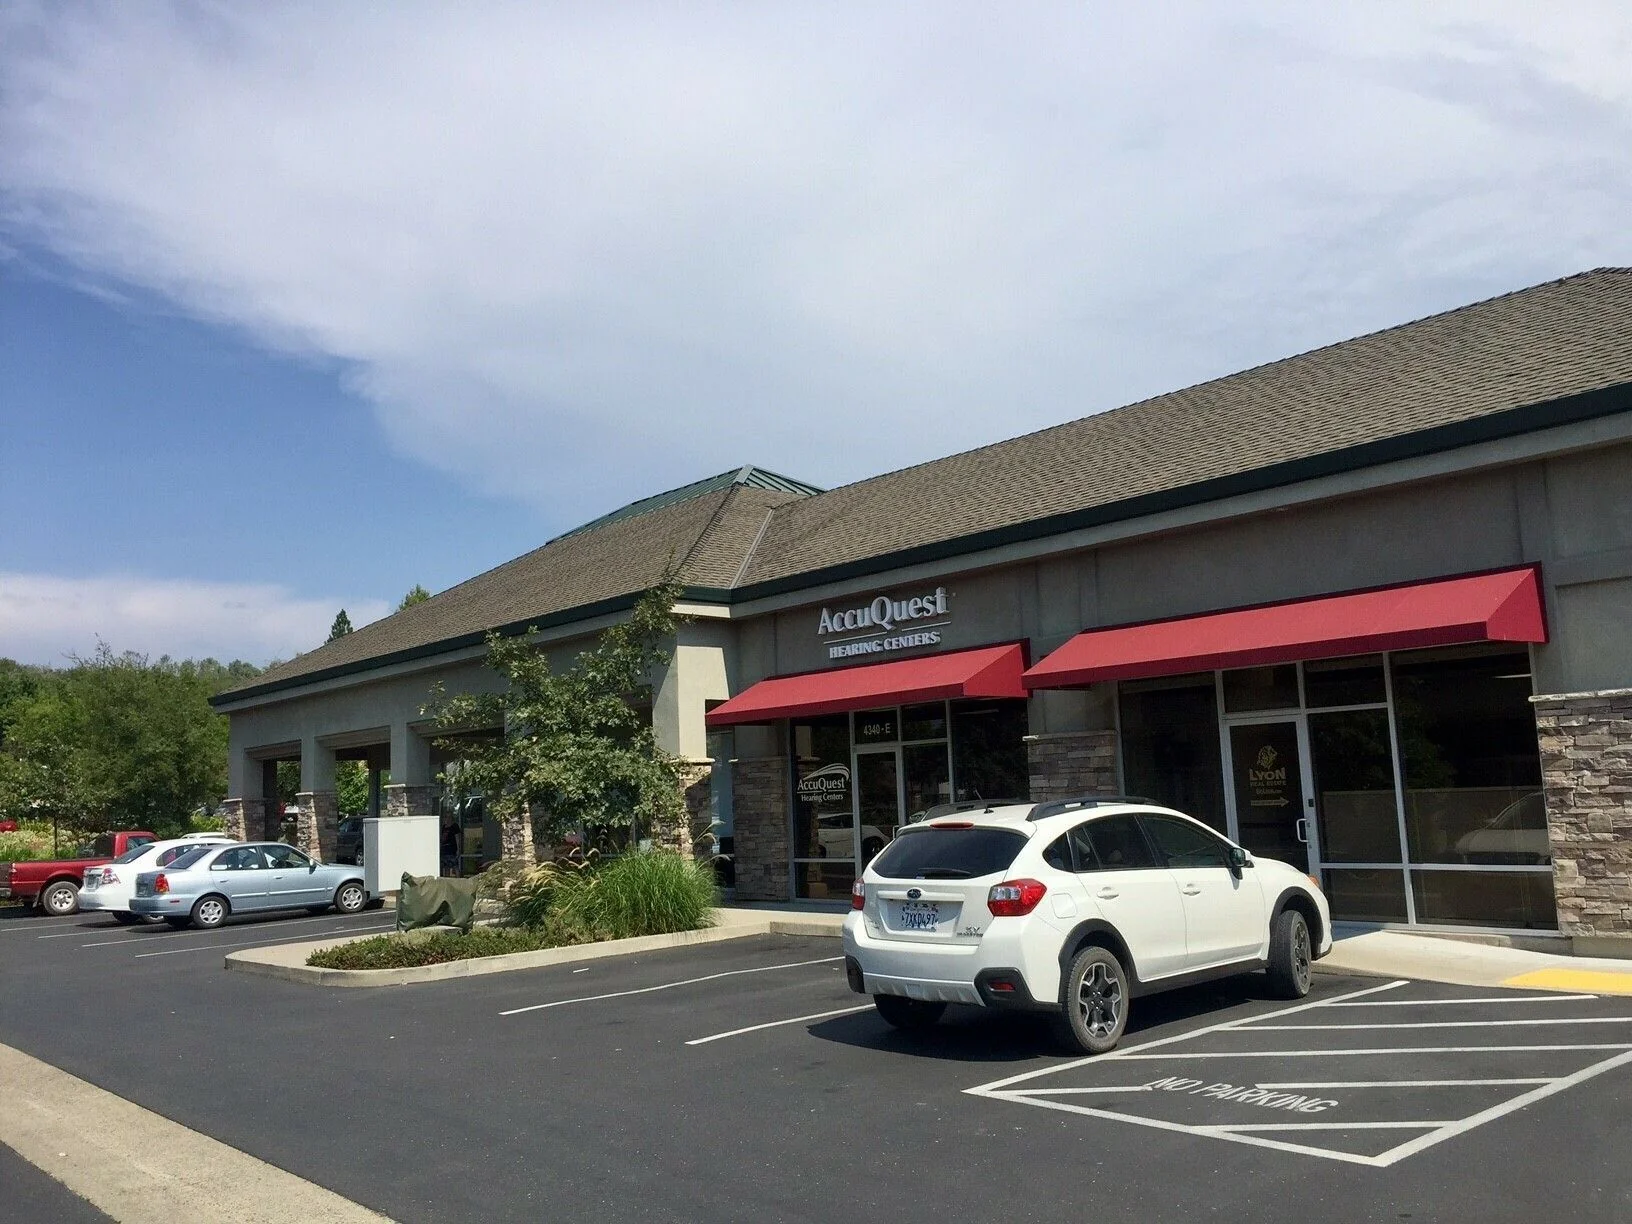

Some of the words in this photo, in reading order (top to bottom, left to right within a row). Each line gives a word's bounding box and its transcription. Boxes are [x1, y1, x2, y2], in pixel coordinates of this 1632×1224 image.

[818, 586, 950, 634] AccuQuest
[829, 640, 883, 659] HEARING
[883, 631, 941, 650] CENTERS
[797, 777, 845, 792] AccuQuest
[1249, 767, 1287, 781] LYON
[801, 793, 823, 803] Hearing
[822, 793, 844, 801] Centers
[1142, 1076, 1203, 1092] NO
[1189, 1083, 1339, 1112] PARKING
